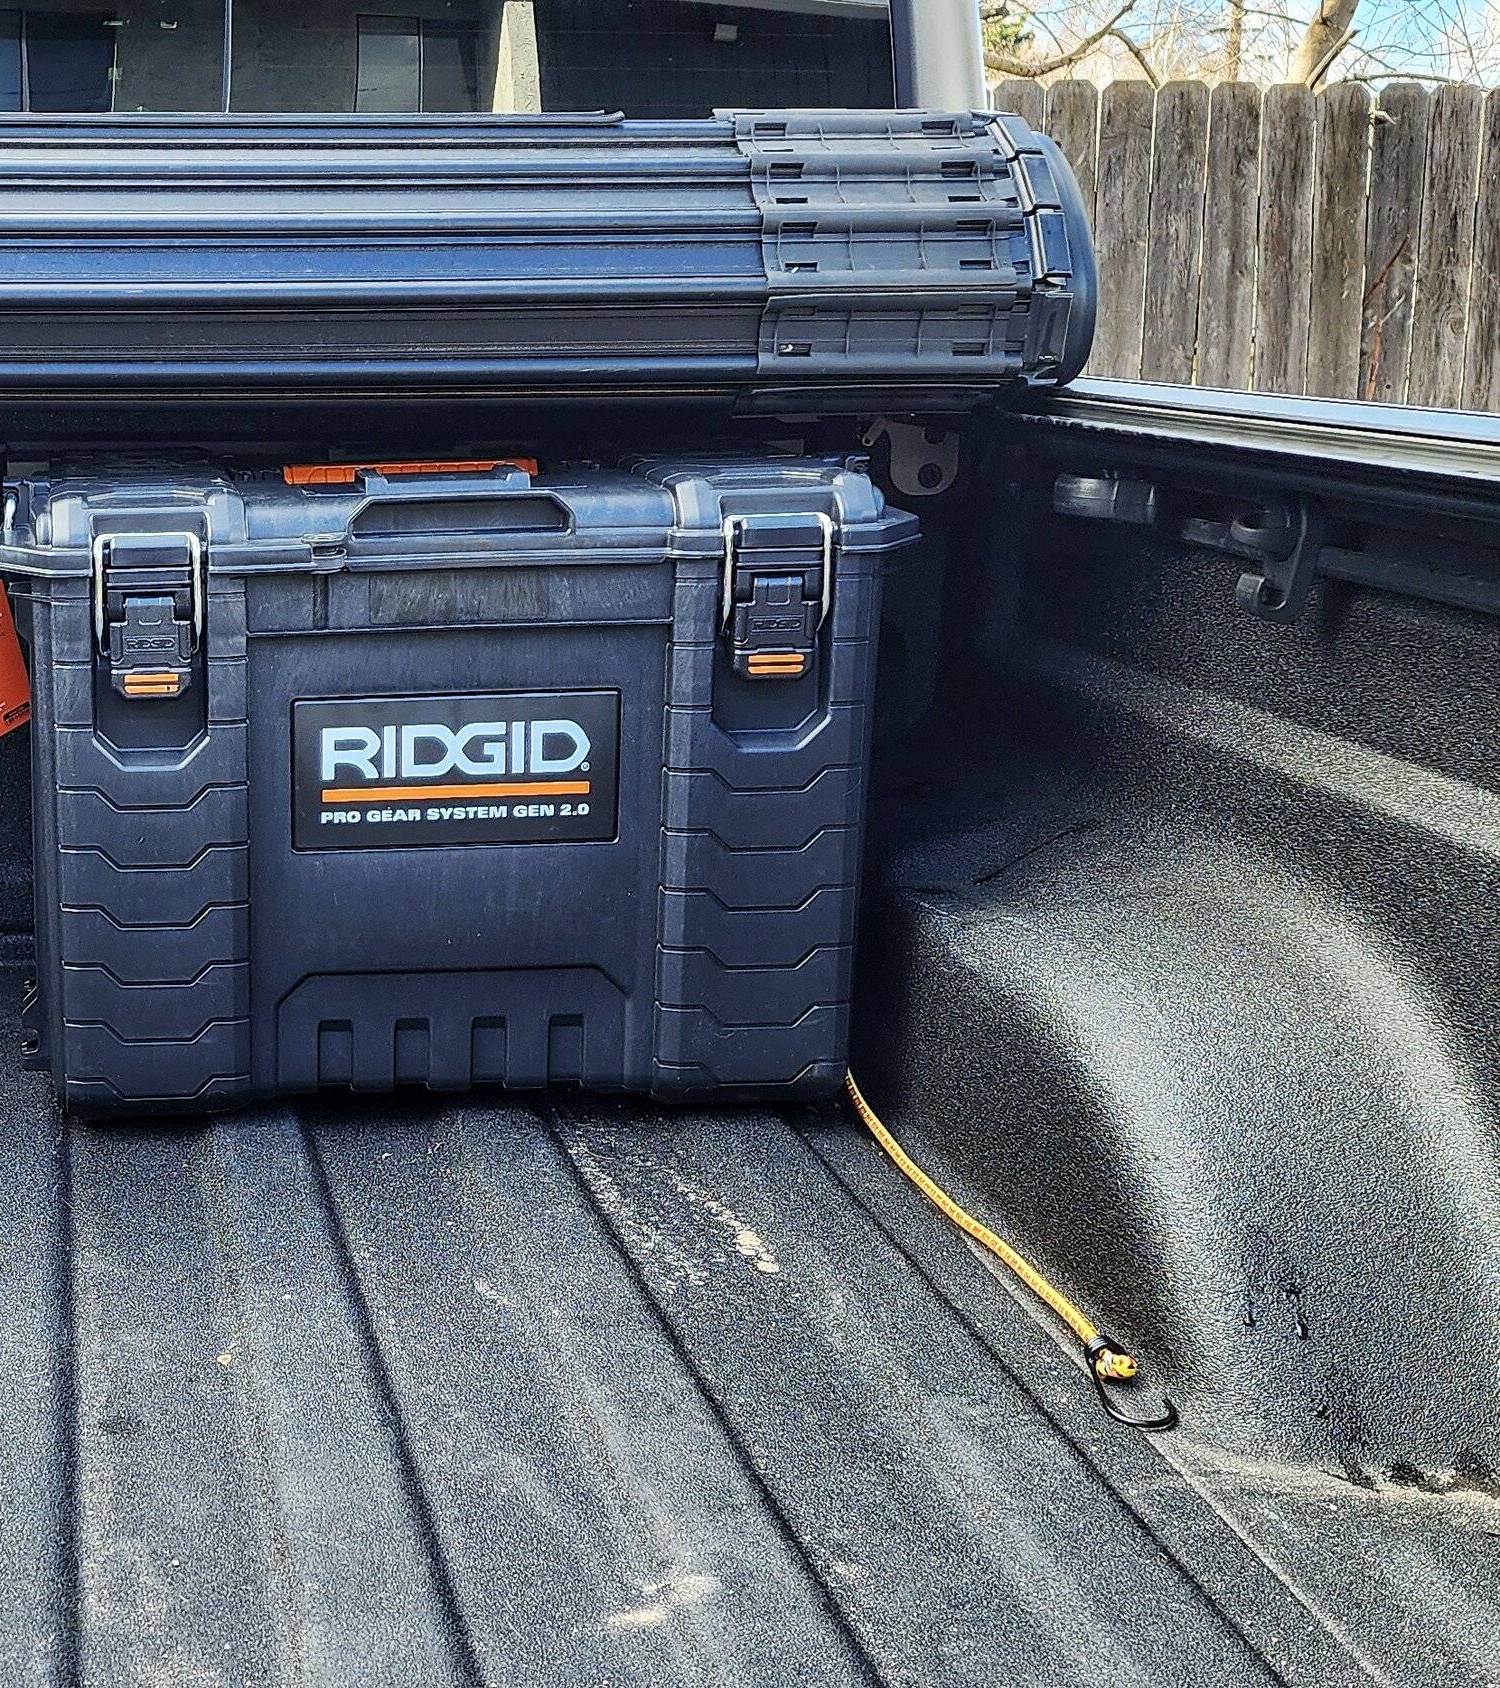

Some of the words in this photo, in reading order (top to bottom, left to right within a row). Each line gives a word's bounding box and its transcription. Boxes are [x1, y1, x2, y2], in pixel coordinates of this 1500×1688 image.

[751, 617, 802, 630] RDGD
[125, 637, 176, 650] RDGD
[322, 719, 591, 780] RIDGID
[320, 811, 361, 824] PRO
[366, 808, 422, 822] GEAR
[427, 805, 508, 821] SYSTEM
[513, 804, 555, 818] GEN
[559, 803, 590, 816] 2.0
